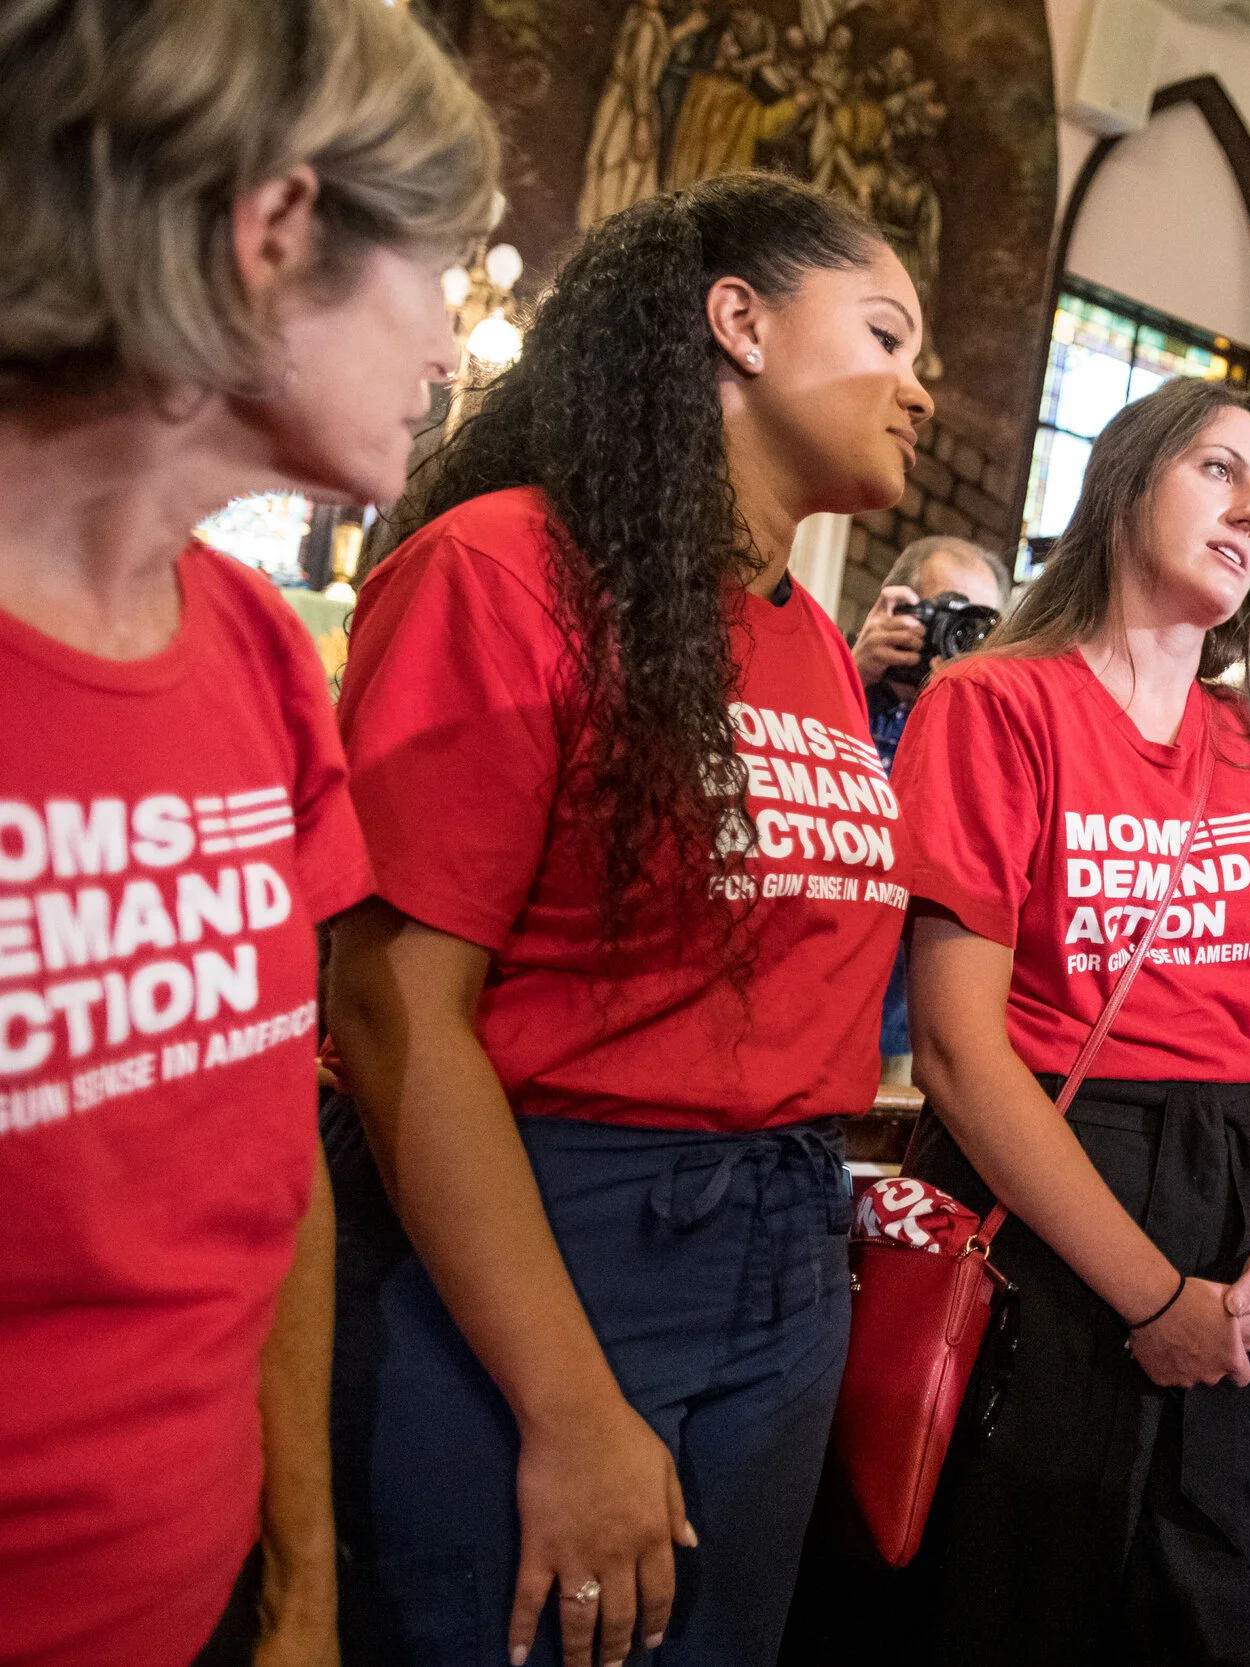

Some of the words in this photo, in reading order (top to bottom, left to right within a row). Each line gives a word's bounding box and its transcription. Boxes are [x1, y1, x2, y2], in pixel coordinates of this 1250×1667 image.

[703, 702, 836, 760] OMS
[0, 794, 196, 882] OMS
[709, 808, 894, 871] ACTION
[0, 863, 291, 978] EMAND
[763, 873, 803, 898] GUN
[806, 875, 842, 900] SENSE
[843, 877, 858, 901] IN
[864, 880, 909, 910] AMERI
[1065, 900, 1226, 945] ACTON
[1068, 953, 1101, 975] FOR
[1173, 946, 1190, 965] IN
[0, 944, 258, 1074] CTION
[162, 1041, 198, 1081] IN
